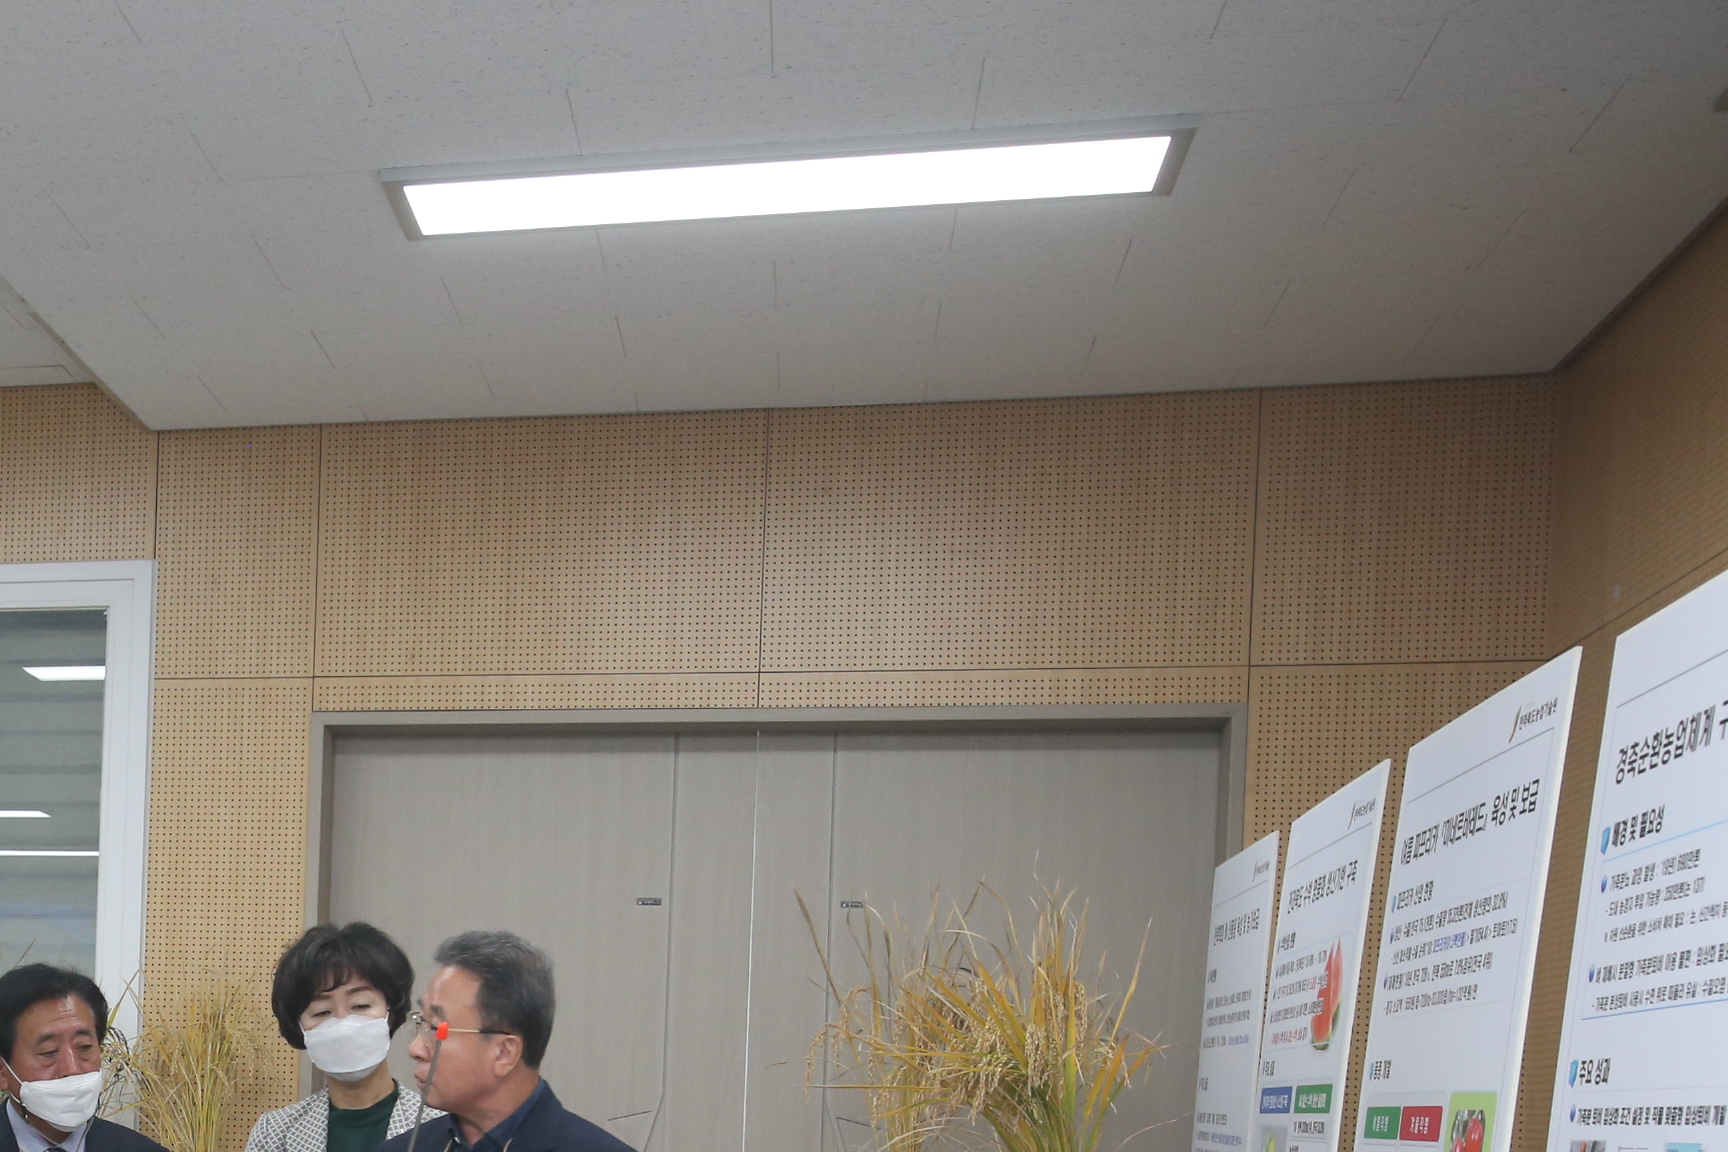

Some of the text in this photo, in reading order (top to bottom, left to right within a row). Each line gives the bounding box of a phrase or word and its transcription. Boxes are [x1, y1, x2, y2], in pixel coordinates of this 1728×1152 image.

[1616, 706, 1715, 784] 경축순환농업체계
[1401, 837, 1414, 865] 여름
[1413, 824, 1439, 860] 파프리카
[1491, 791, 1509, 826] 육성
[1508, 787, 1520, 821] 및
[1519, 779, 1539, 815] 보급
[1612, 806, 1665, 847] 배경 및 필요성
[1347, 860, 1358, 886] 구축
[1644, 863, 1655, 882] 발생
[1679, 950, 1691, 969] 불편
[1579, 1058, 1610, 1085] 주요 성과
[1577, 1106, 1726, 1125] 가축분 퇴비 입상화 조건 설정 및 작물 맞춤형 입상퇴비 개발
